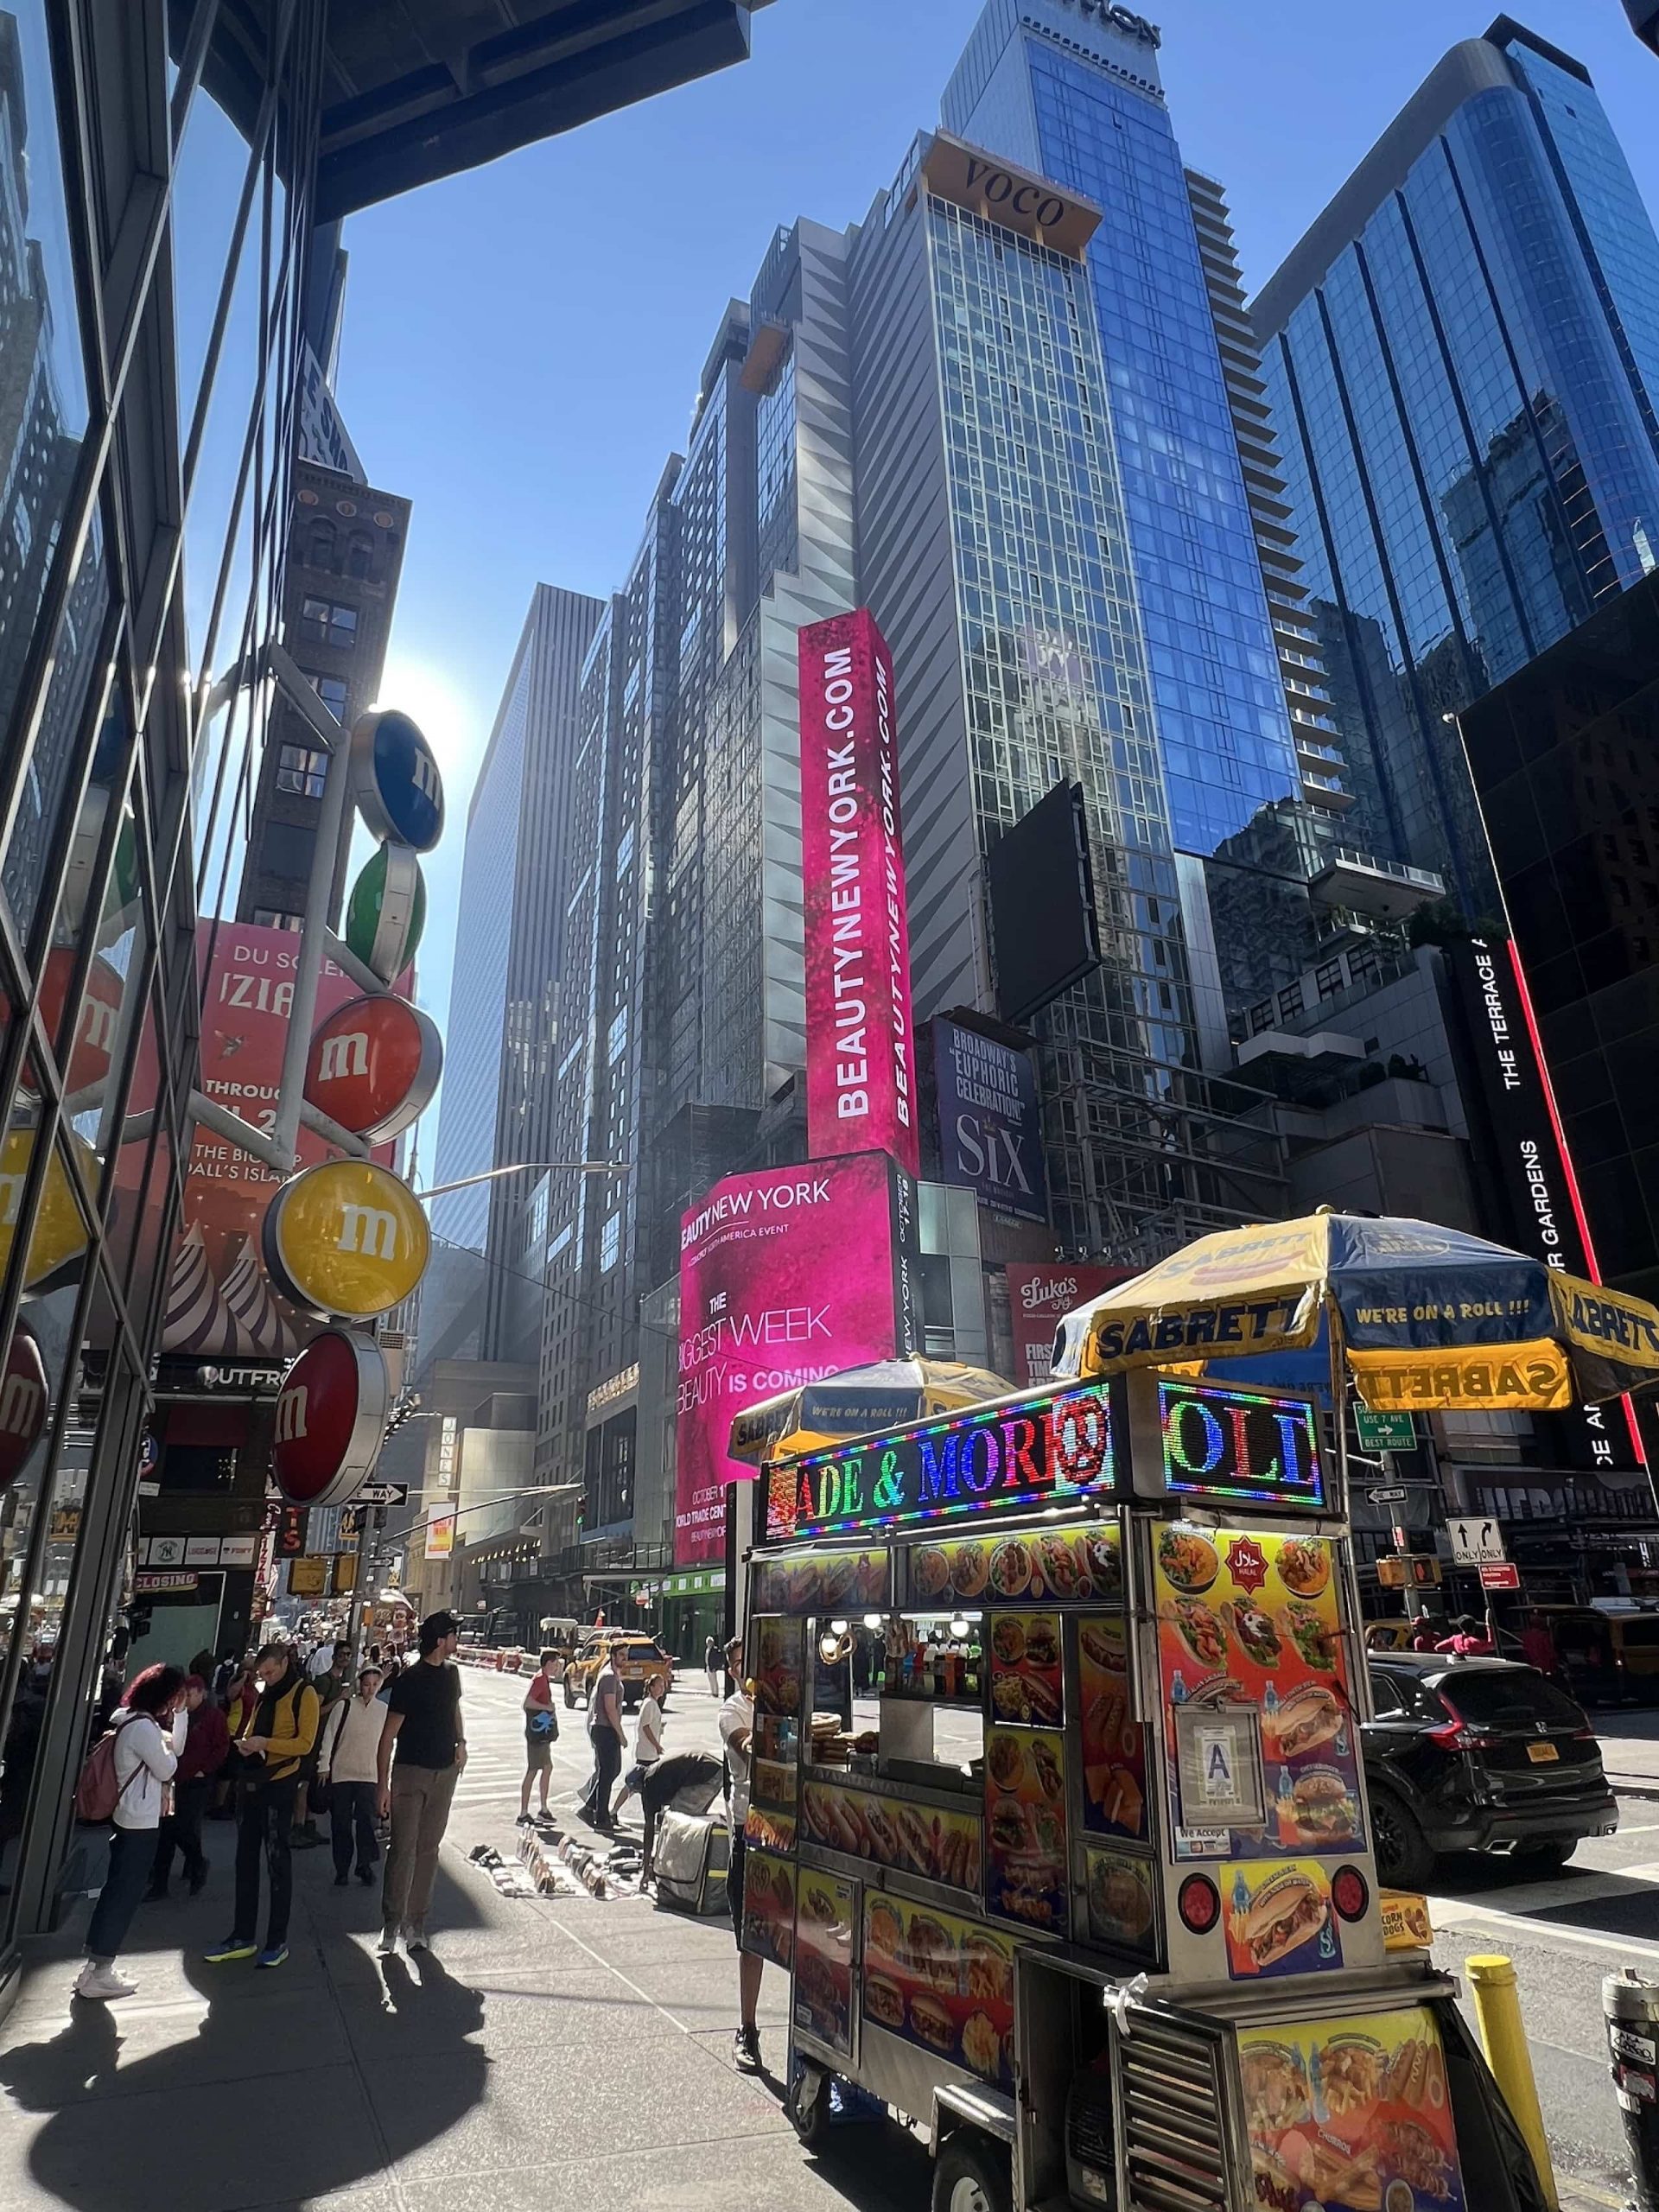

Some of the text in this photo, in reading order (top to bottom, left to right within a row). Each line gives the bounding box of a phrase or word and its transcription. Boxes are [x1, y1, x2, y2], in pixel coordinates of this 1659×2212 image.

[823, 646, 869, 1120] BEAUTYNEWYORK.COM
[877, 656, 911, 1128] BEAUTYNEWYORK.COM
[233, 945, 270, 965] DU
[1476, 954, 1510, 1045] TERRACE
[317, 1032, 370, 1082] m
[952, 1028, 1017, 1074] BROADWAY'S
[1497, 1049, 1521, 1090] THE
[206, 1079, 281, 1100] THROU
[194, 1144, 227, 1161] THE
[956, 1113, 1035, 1195] SIX
[757, 1178, 830, 1211] YORK
[1521, 1140, 1560, 1245] GARDENS
[337, 1201, 398, 1262] m
[759, 1224, 789, 1236] EVENT
[900, 1255, 910, 1312] YORK
[709, 1292, 727, 1316] THE
[1356, 1299, 1530, 1325] WE'RE ON A ROLL !!!
[730, 1304, 832, 1349] WEEK
[1570, 1290, 1659, 1351] ABRETT
[217, 1367, 288, 1386] UTFR
[728, 1375, 747, 1393] IS
[811, 1406, 842, 1416] WE'RE
[861, 1408, 868, 1417] A
[870, 1408, 893, 1417] ROLL
[1363, 1414, 1379, 1424] USE
[440, 1417, 454, 1484] JONES
[1364, 1438, 1411, 1447] BEST ROUTE
[372, 1490, 393, 1499] WAY
[795, 1459, 864, 1521] ADE
[872, 1450, 906, 1508] &
[1456, 1548, 1502, 1560] ONLY ONLY
[1207, 1744, 1230, 1780] A
[1197, 1827, 1226, 1841] Accept
[1381, 1911, 1403, 1925] CORN
[1382, 1921, 1405, 1936] DOGS
